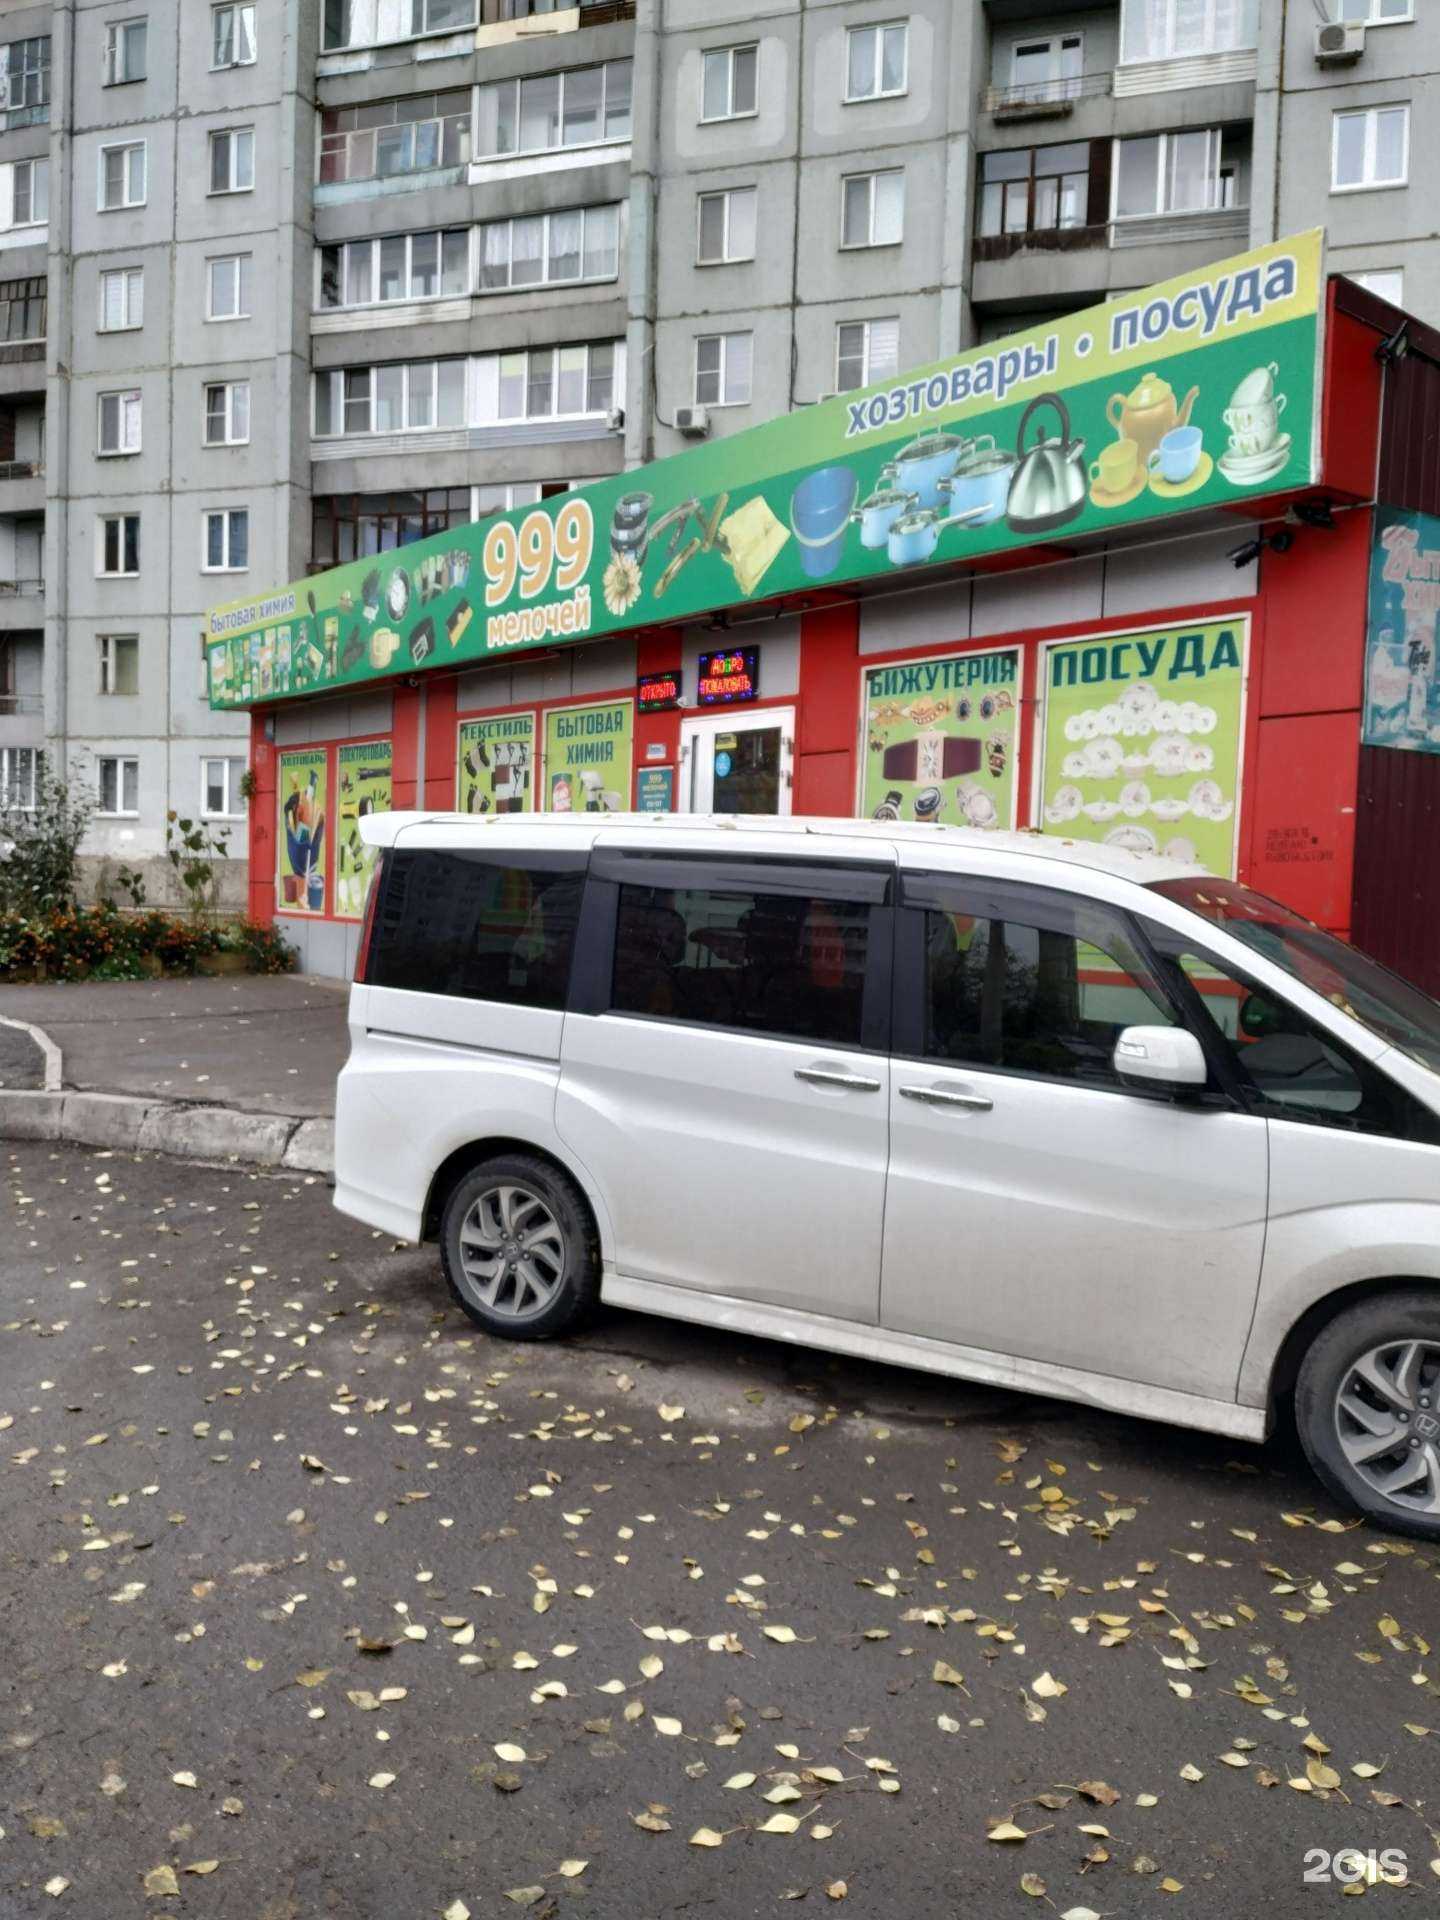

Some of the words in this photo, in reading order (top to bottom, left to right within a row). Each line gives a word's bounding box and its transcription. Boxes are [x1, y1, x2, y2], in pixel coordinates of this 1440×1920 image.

[846, 336, 1057, 438] хозтовары
[1112, 255, 1296, 352] посуда
[484, 498, 594, 607] 999
[210, 605, 257, 634] бытовая
[259, 593, 295, 619] химия
[487, 584, 592, 648] мелочей
[869, 654, 1016, 698] БИЖУТЕРИЯ
[1053, 630, 1240, 687] ПОСУДА
[640, 681, 676, 701] ОТКРЫТО
[463, 719, 533, 740] ТЕКСТИЛЬ
[556, 710, 623, 738] БЫТОВАЯ
[567, 740, 614, 765] ХИМИЯ
